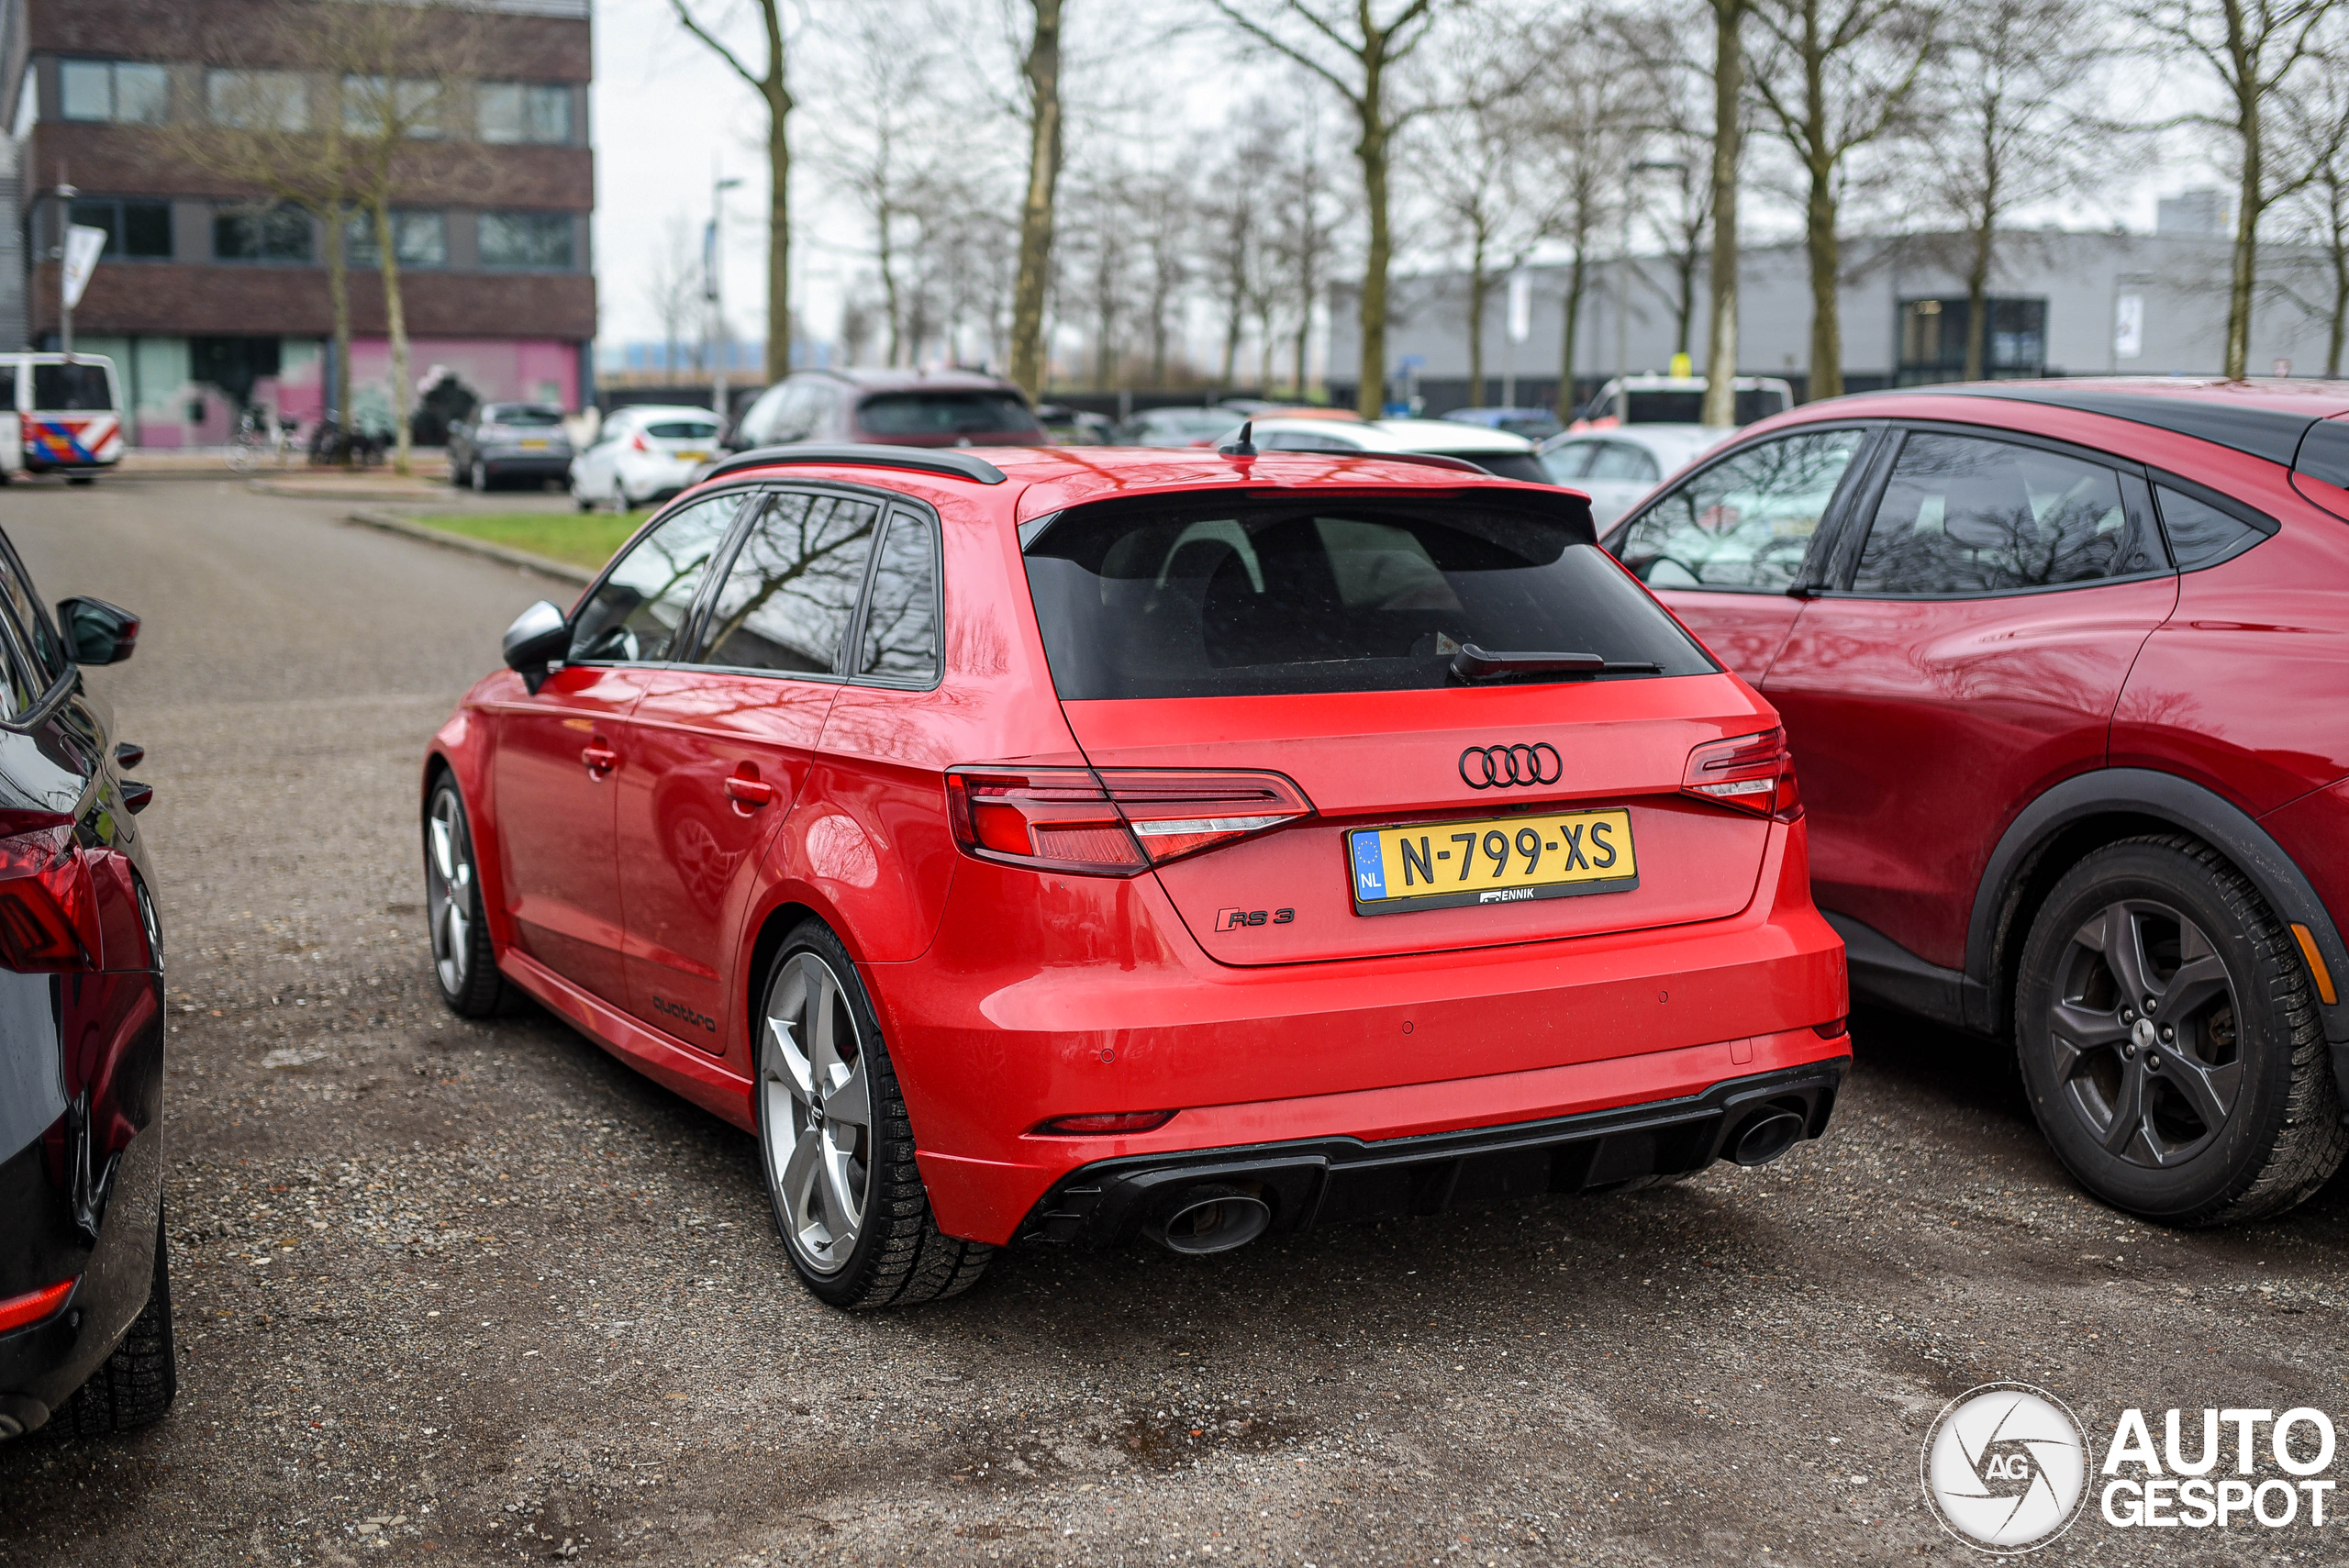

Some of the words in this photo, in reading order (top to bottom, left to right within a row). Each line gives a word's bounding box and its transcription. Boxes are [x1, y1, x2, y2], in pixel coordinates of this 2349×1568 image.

[1399, 822, 1618, 886] N-799-XS
[1360, 872, 1382, 888] NL
[1228, 911, 1268, 929] RS
[1273, 907, 1295, 925] 3
[652, 995, 716, 1033] quattro
